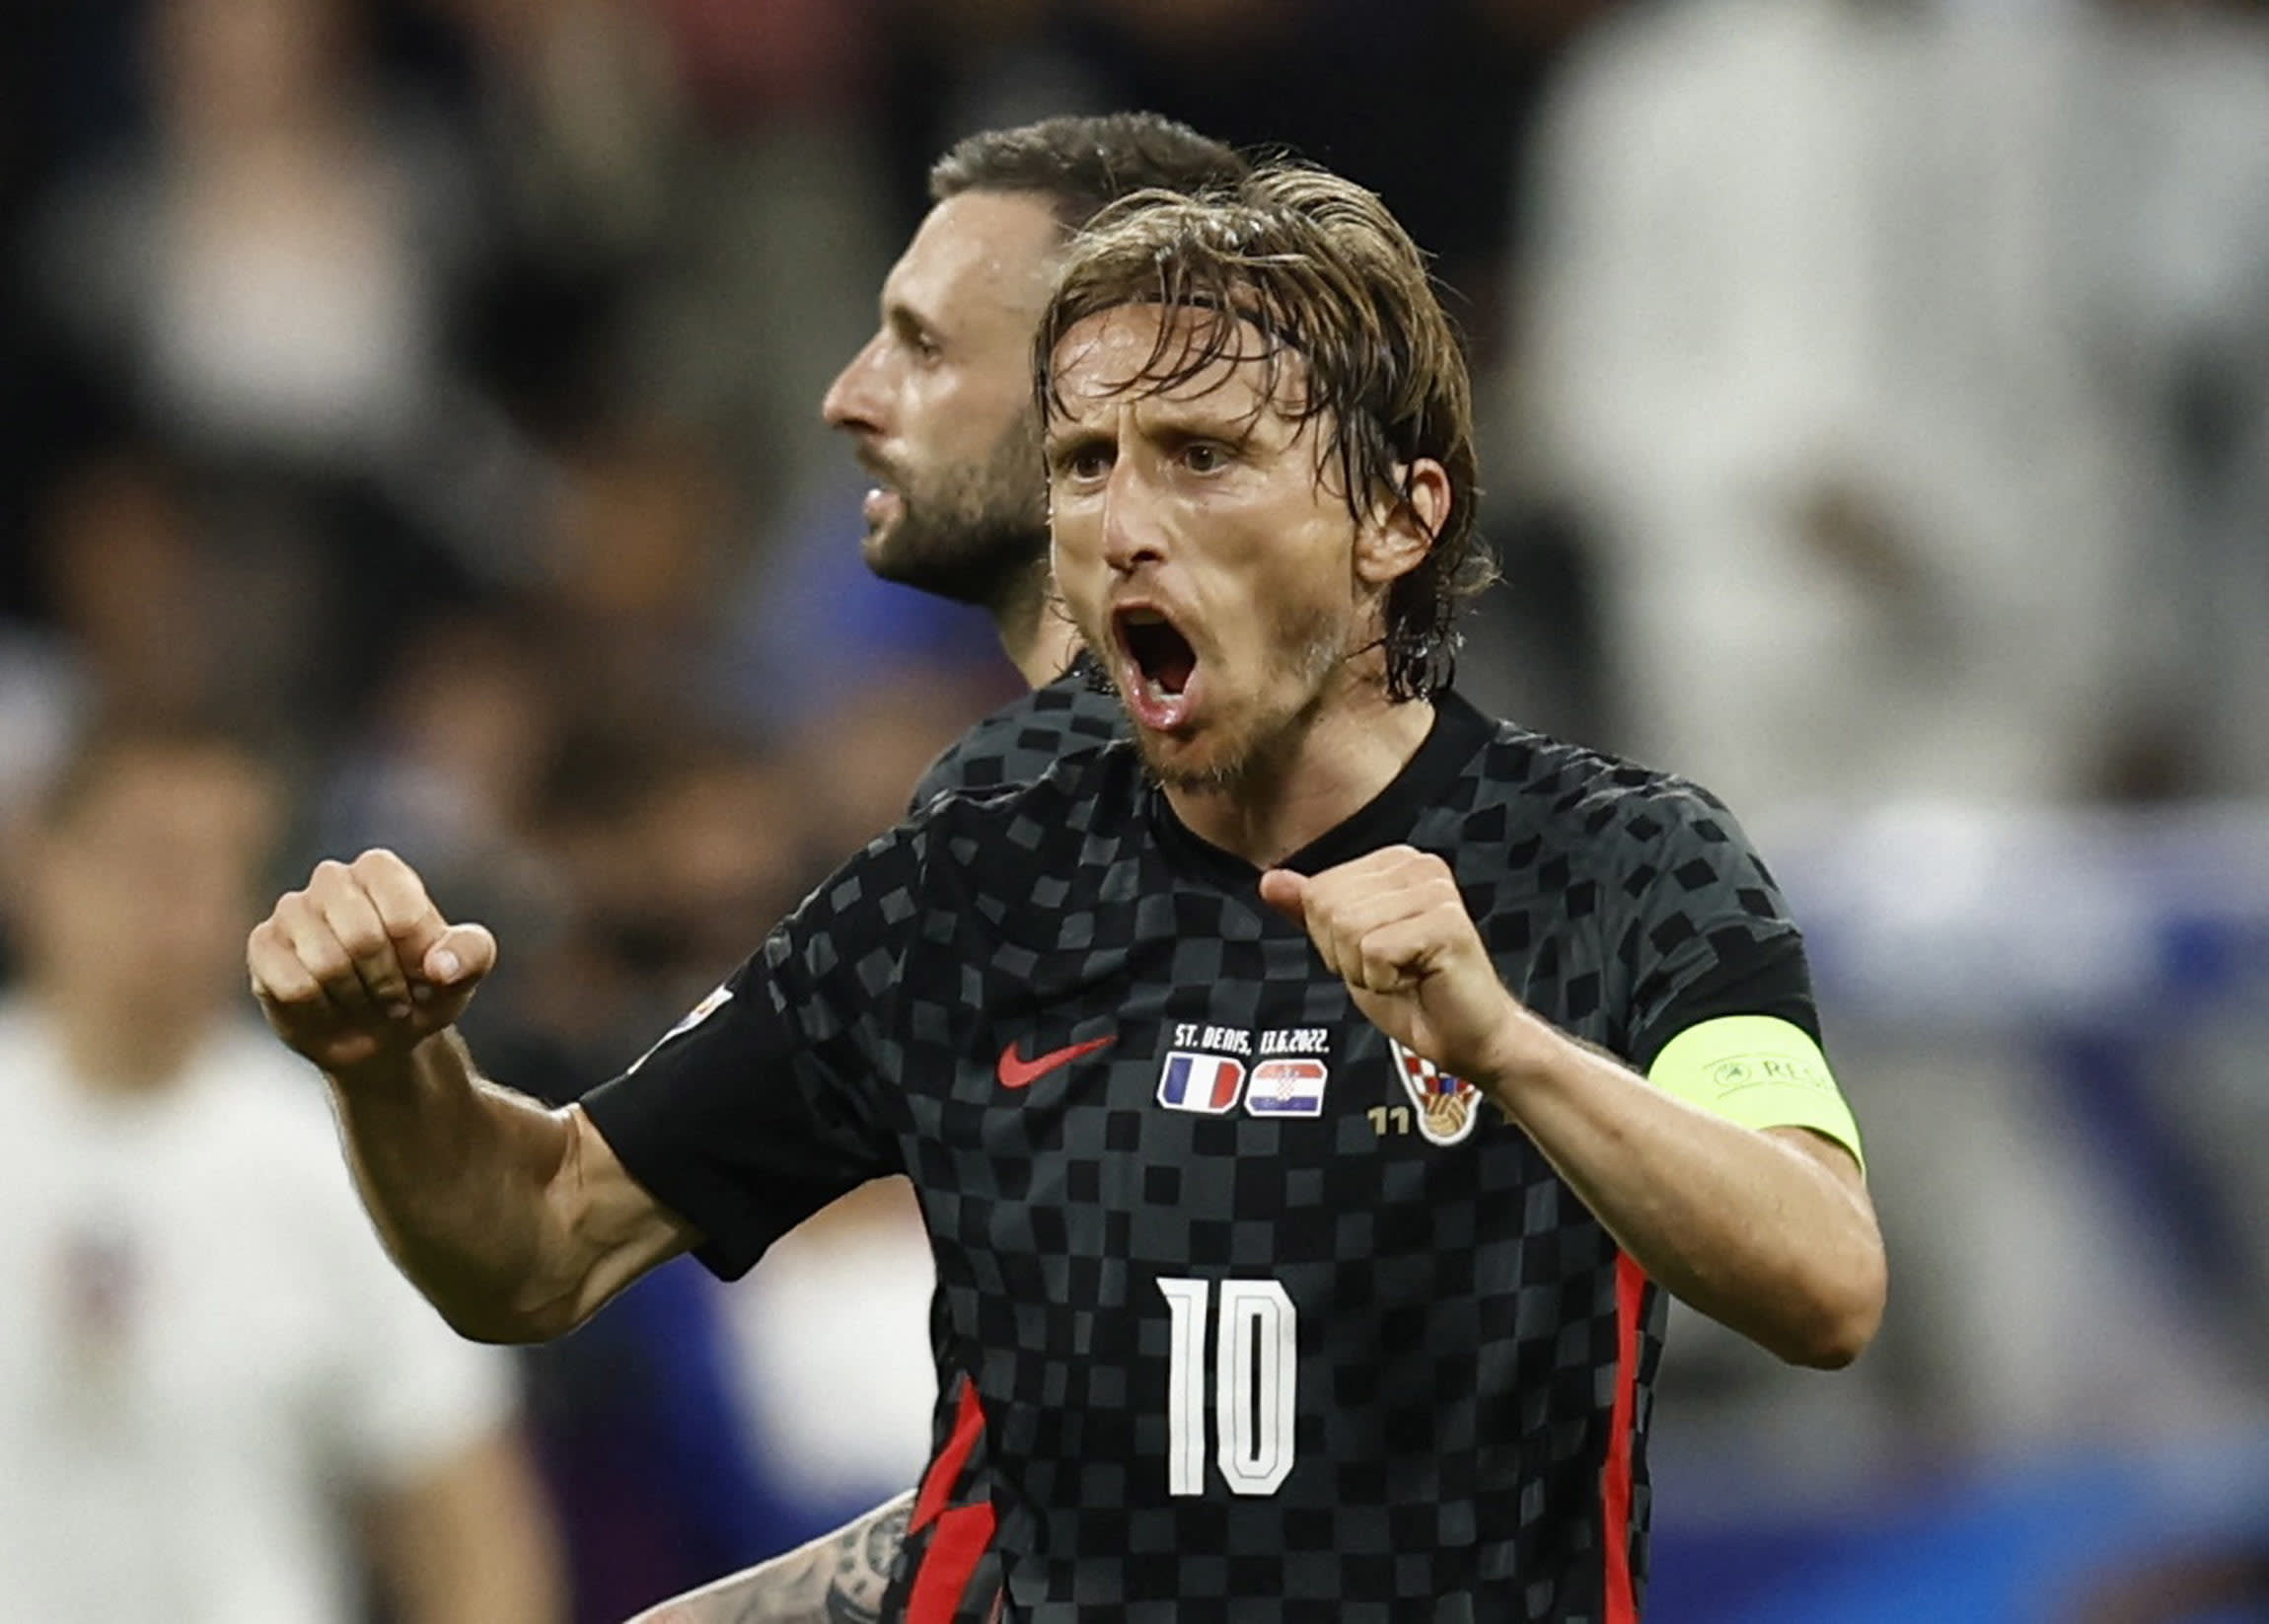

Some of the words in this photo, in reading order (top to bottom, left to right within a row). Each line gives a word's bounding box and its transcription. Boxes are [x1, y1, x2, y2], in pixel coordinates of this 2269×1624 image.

[1174, 1023, 1198, 1048] ST.
[1202, 1026, 1252, 1056] DENIS,
[1367, 1105, 1410, 1135] 11
[1155, 1277, 1297, 1496] 10
